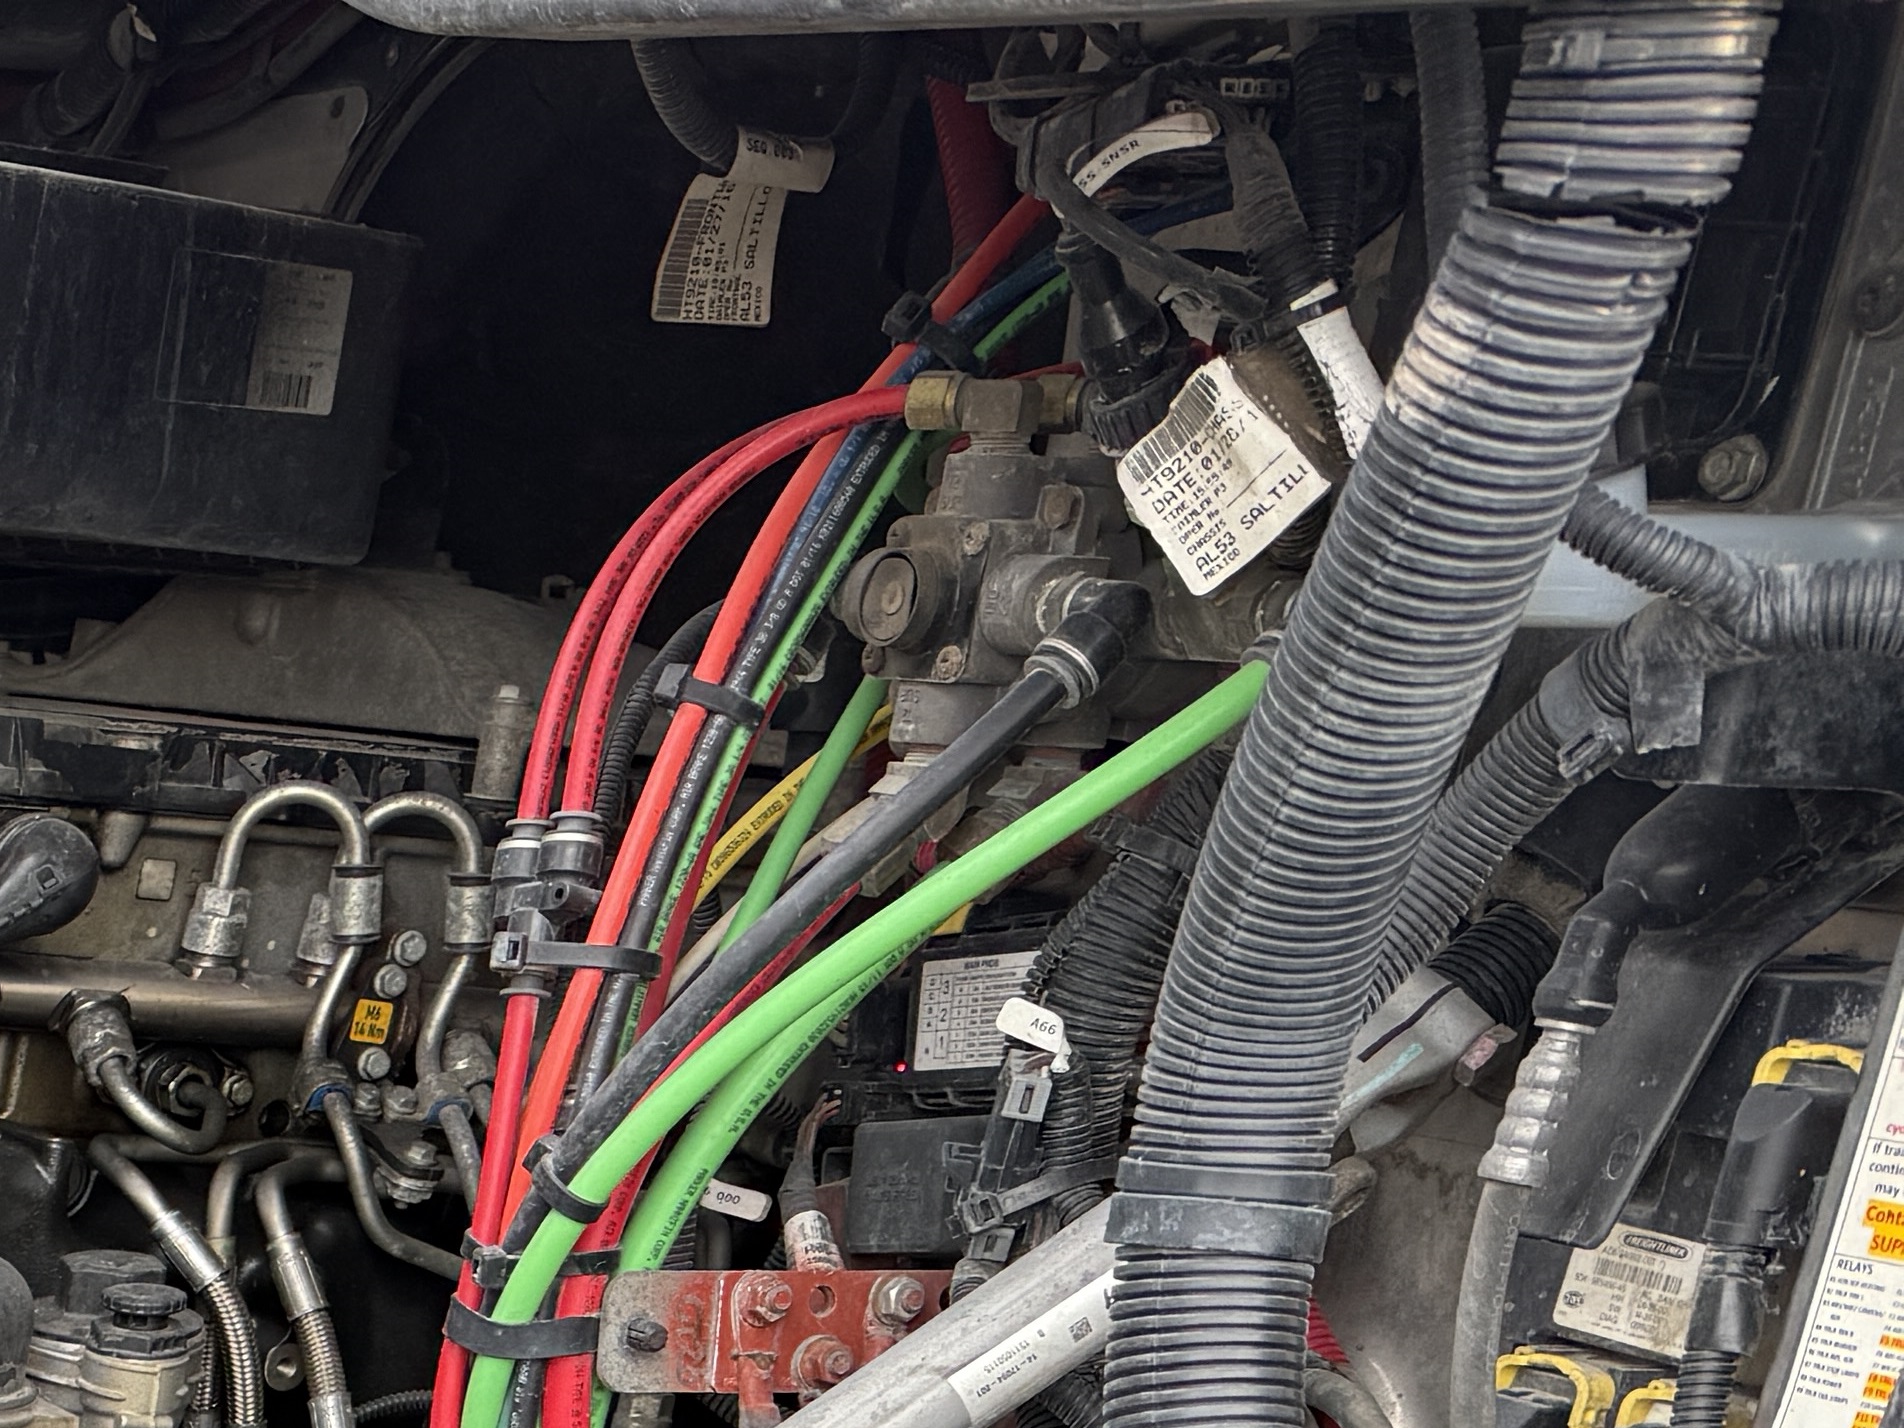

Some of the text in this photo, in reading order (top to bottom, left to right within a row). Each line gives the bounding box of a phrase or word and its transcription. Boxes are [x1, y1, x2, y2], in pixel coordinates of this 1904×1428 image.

[1195, 531, 1238, 572] AL53
[1203, 548, 1242, 581] MEXICO
[1874, 1182, 1901, 1198] may
[1836, 1258, 1874, 1275] RELAYS
